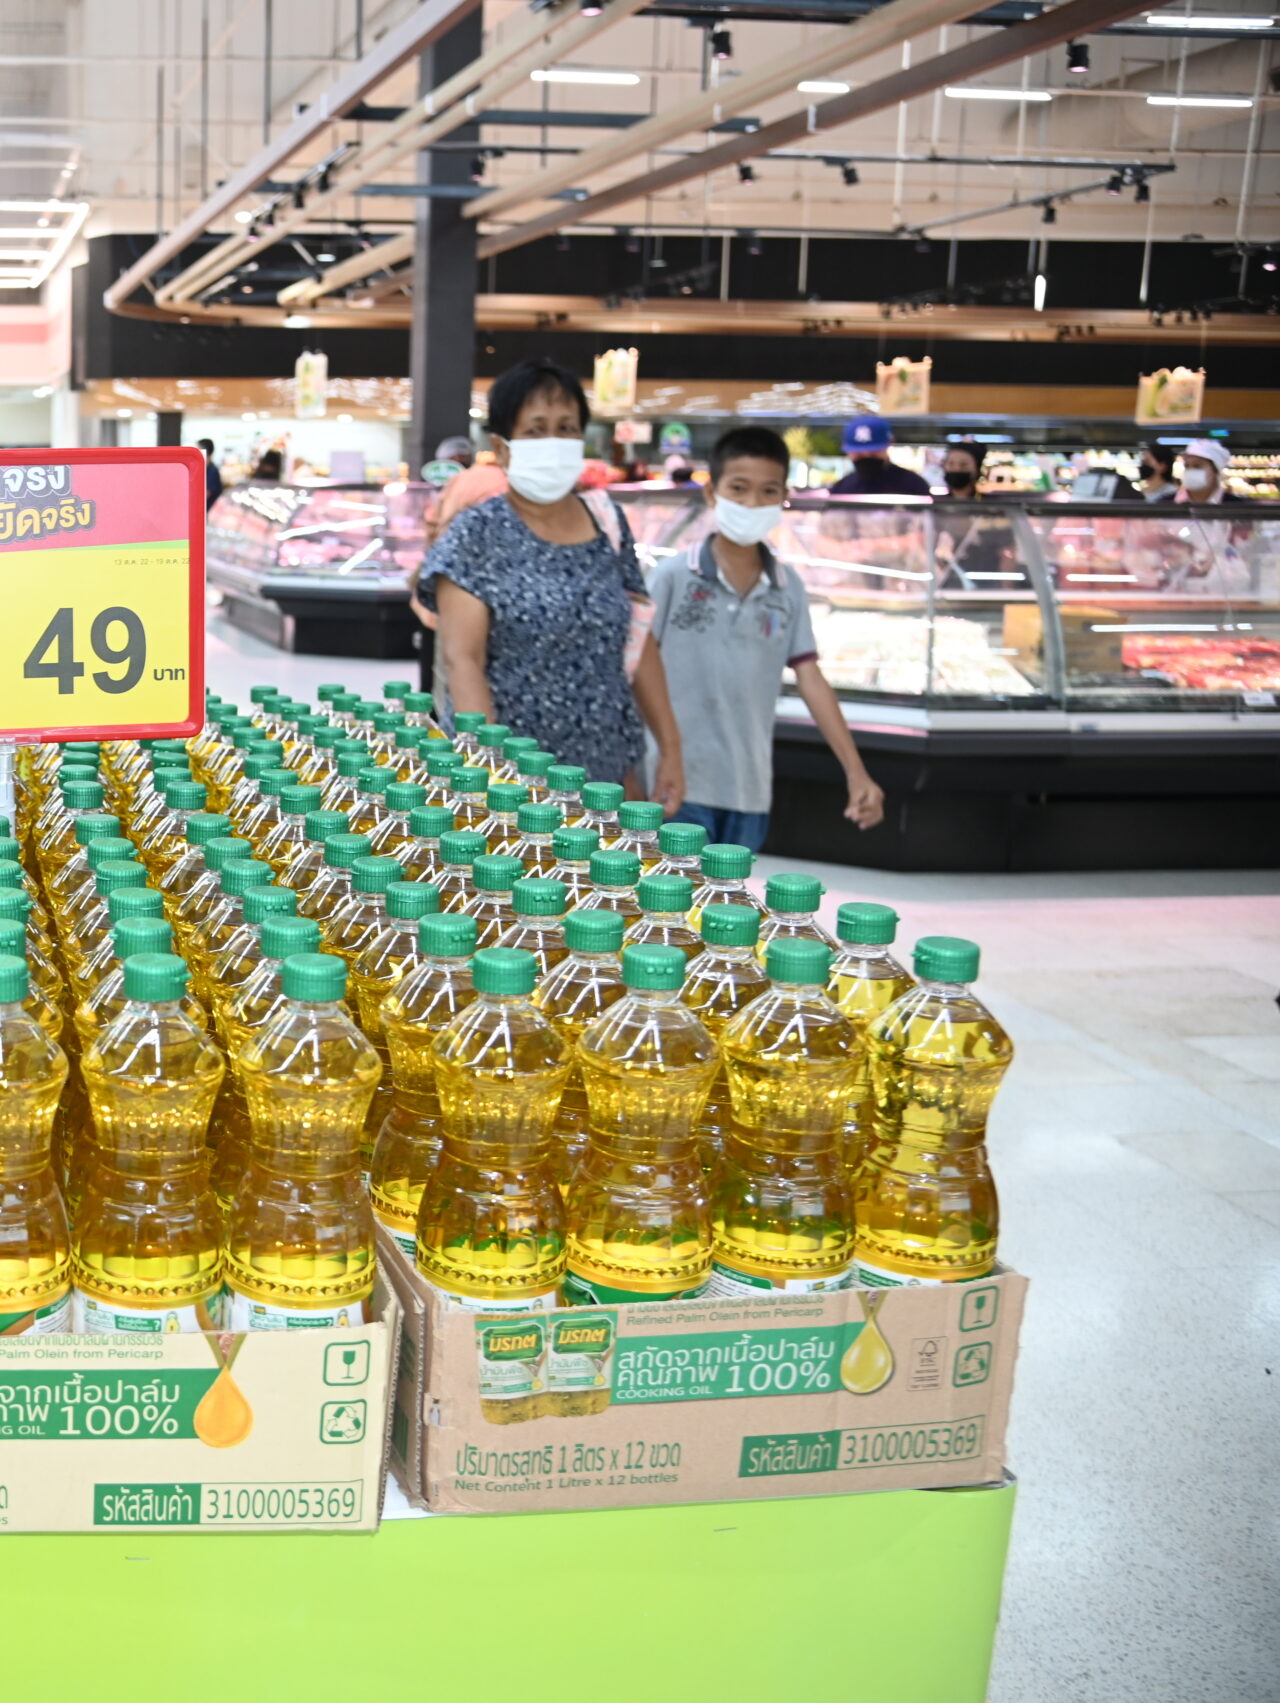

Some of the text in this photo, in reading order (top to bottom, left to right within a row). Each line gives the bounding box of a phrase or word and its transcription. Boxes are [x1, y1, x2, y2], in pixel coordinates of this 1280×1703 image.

[23, 606, 186, 695] 49 บาท
[626, 1305, 824, 1326] Refined Palm Olein from Pericarp
[489, 1333, 538, 1352] มรกต
[558, 1328, 607, 1344] มรกต
[34, 1348, 69, 1359] Olein
[72, 1348, 103, 1359] from
[108, 1348, 164, 1360] Pericarp
[617, 1333, 836, 1369] สกัดจากเนื้อปาล์ม
[617, 1360, 832, 1393] คุณภาพ 100%
[616, 1385, 713, 1400] COOKING OIL
[18, 1425, 46, 1435] OIL
[59, 1404, 179, 1436] 100%
[558, 1446, 567, 1473] 1
[572, 1443, 606, 1473] ลิตร
[609, 1448, 619, 1471] x
[624, 1441, 645, 1469] 12
[650, 1442, 682, 1468] ขวด
[747, 1422, 977, 1474] รหัสสินค้า 3100005369
[454, 1472, 679, 1493] Net Content 1 Litre x 12 bottles
[102, 1485, 356, 1521] รหัสสินค้า 3100005369
